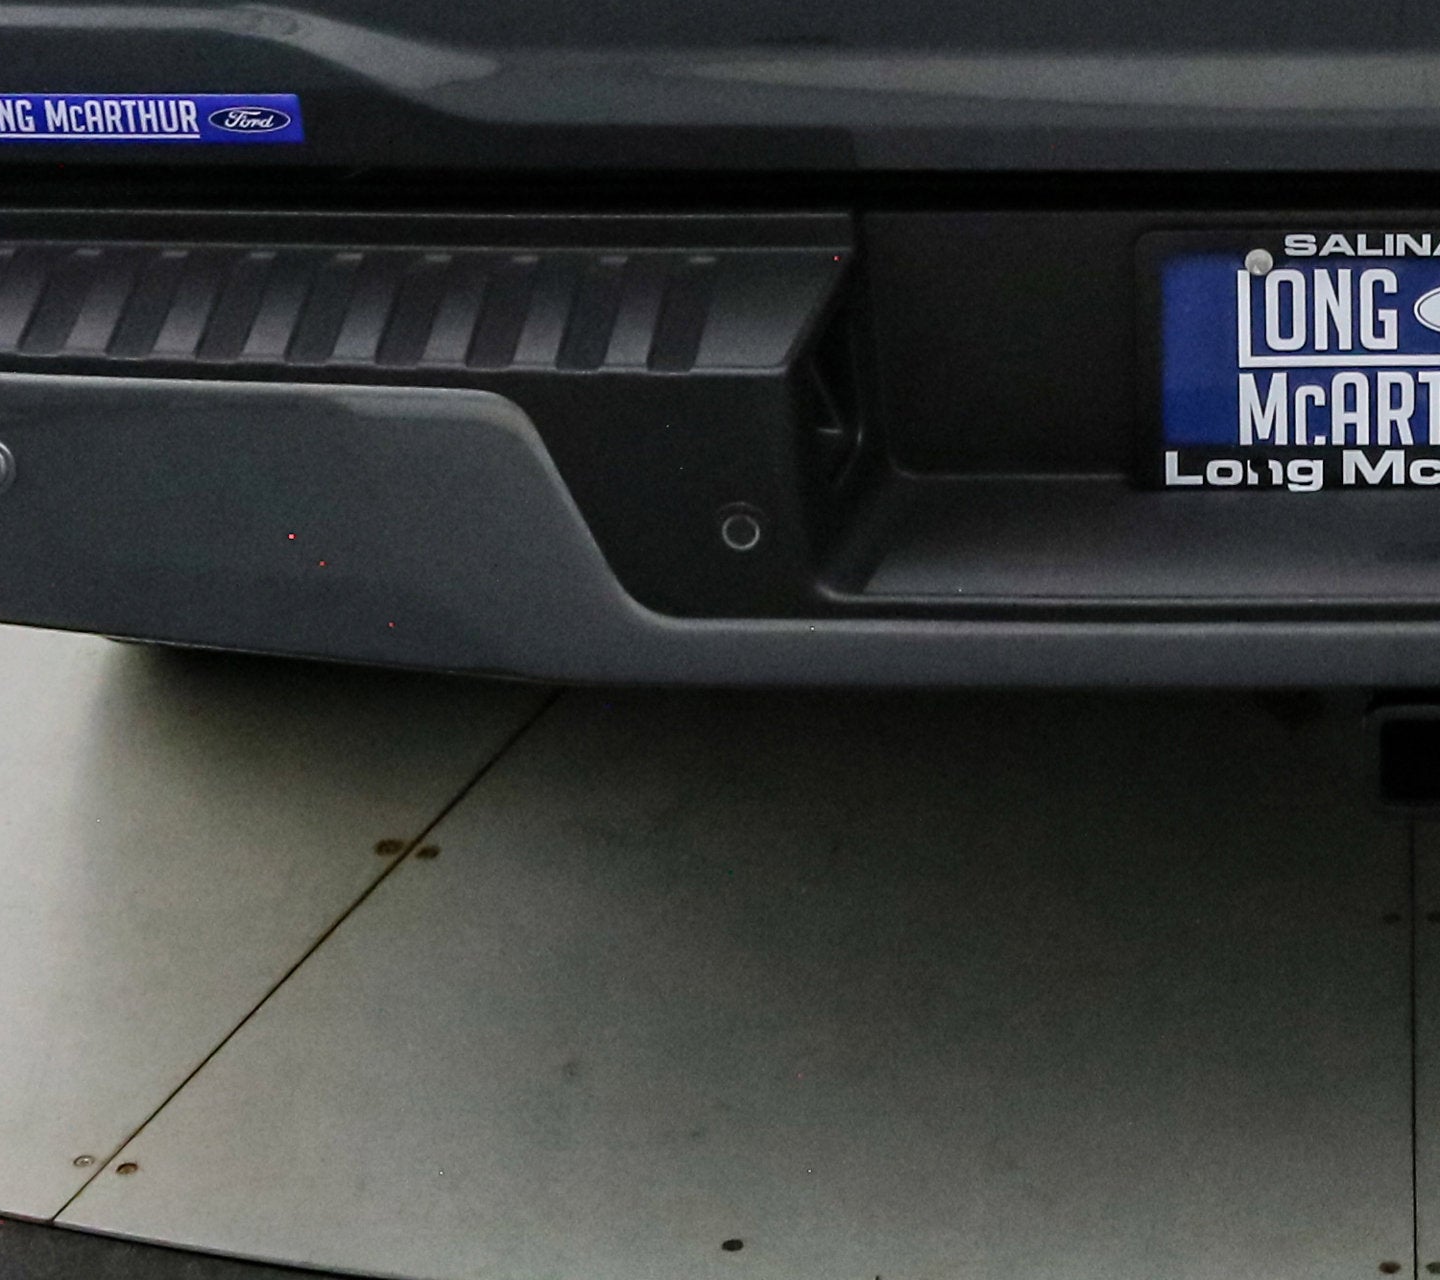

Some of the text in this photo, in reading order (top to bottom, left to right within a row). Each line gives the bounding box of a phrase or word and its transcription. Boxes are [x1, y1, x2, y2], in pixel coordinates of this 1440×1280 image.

[44, 98, 200, 133] McARTHUR
[223, 110, 275, 130] Ford
[1237, 268, 1399, 368] LONG
